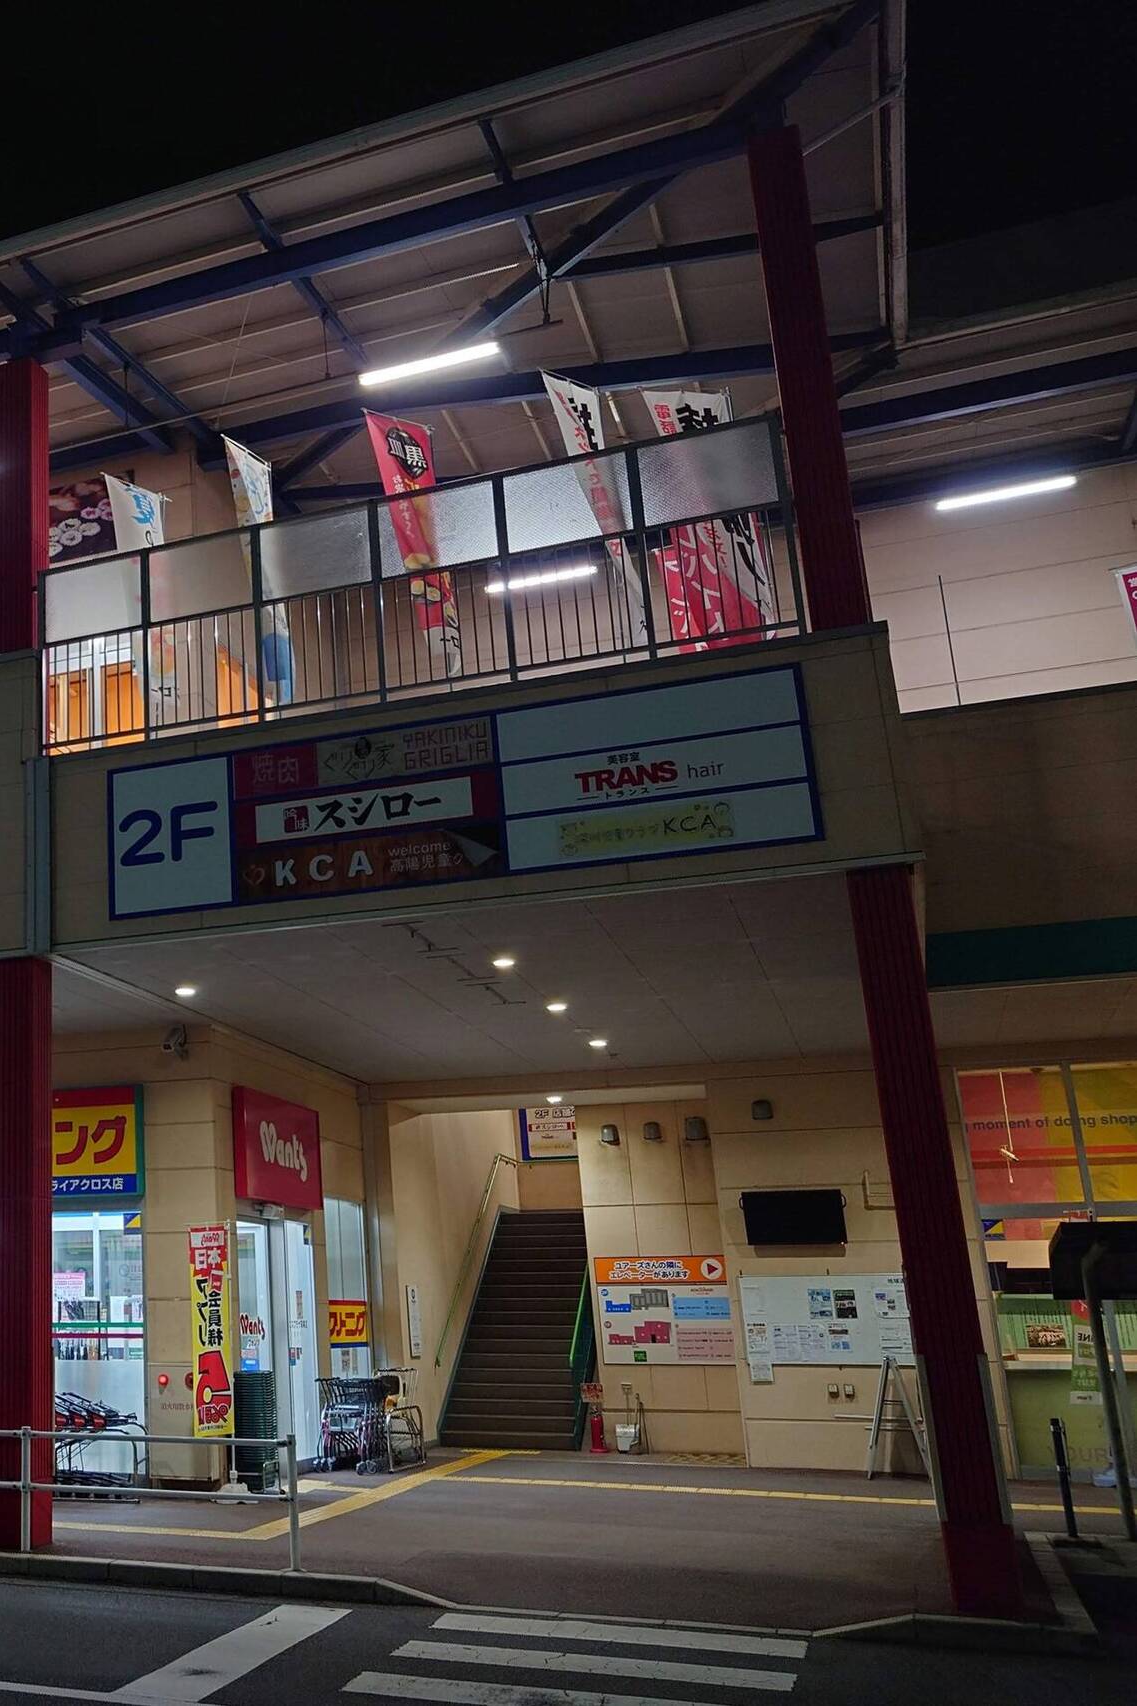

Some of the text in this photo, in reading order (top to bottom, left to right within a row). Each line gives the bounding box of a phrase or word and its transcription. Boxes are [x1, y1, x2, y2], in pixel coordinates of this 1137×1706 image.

[402, 718, 488, 748] YAKINIKU
[252, 753, 300, 785] 焼肉
[404, 741, 489, 772] GRIGLIA
[606, 751, 640, 765] 美容室
[574, 760, 725, 794] TRANS hair
[605, 787, 650, 800] トランス
[314, 792, 442, 832] スシロー
[664, 813, 716, 836] KCA
[118, 801, 219, 867] 2F
[387, 838, 452, 858] welcome
[274, 850, 374, 887] KCA
[973, 1118, 1032, 1131] moment
[1035, 1115, 1050, 1129] of
[1054, 1115, 1097, 1129] dong
[259, 1120, 308, 1183] Wants
[51, 1177, 124, 1192] ライアクロス店
[610, 1270, 689, 1280] エレベーターがあります
[239, 1314, 266, 1340] Wants
